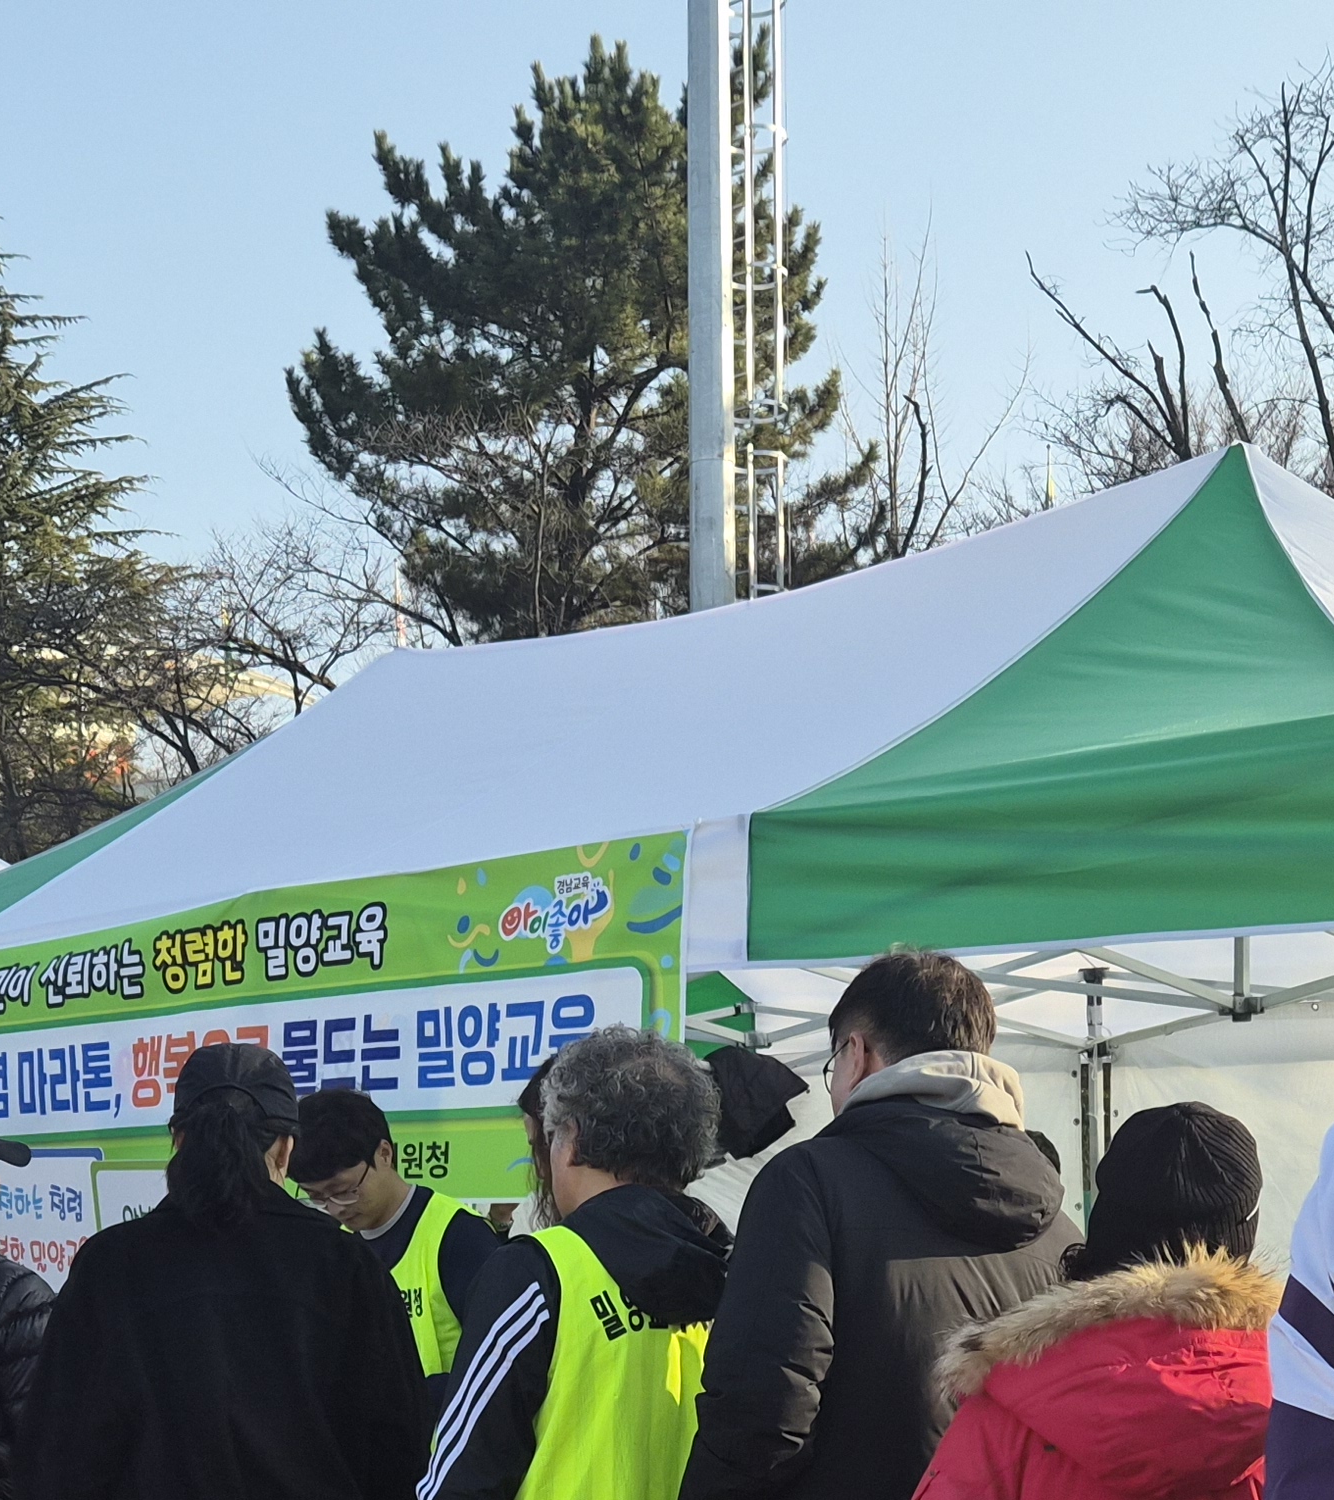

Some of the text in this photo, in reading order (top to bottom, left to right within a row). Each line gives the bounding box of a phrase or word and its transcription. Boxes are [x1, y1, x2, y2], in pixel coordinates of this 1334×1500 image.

[556, 875, 590, 895] 경남교육
[501, 889, 609, 950] 아이좋아
[39, 937, 146, 1006] 신뢰하는
[153, 918, 248, 994] 청렴한
[255, 902, 388, 980] 밀양교육
[17, 1041, 122, 1119] 마라톤,
[282, 1014, 402, 1095] 물드는
[393, 1140, 450, 1179] 원청
[49, 1184, 83, 1222] 청렴
[30, 1236, 89, 1273] 밀양교
